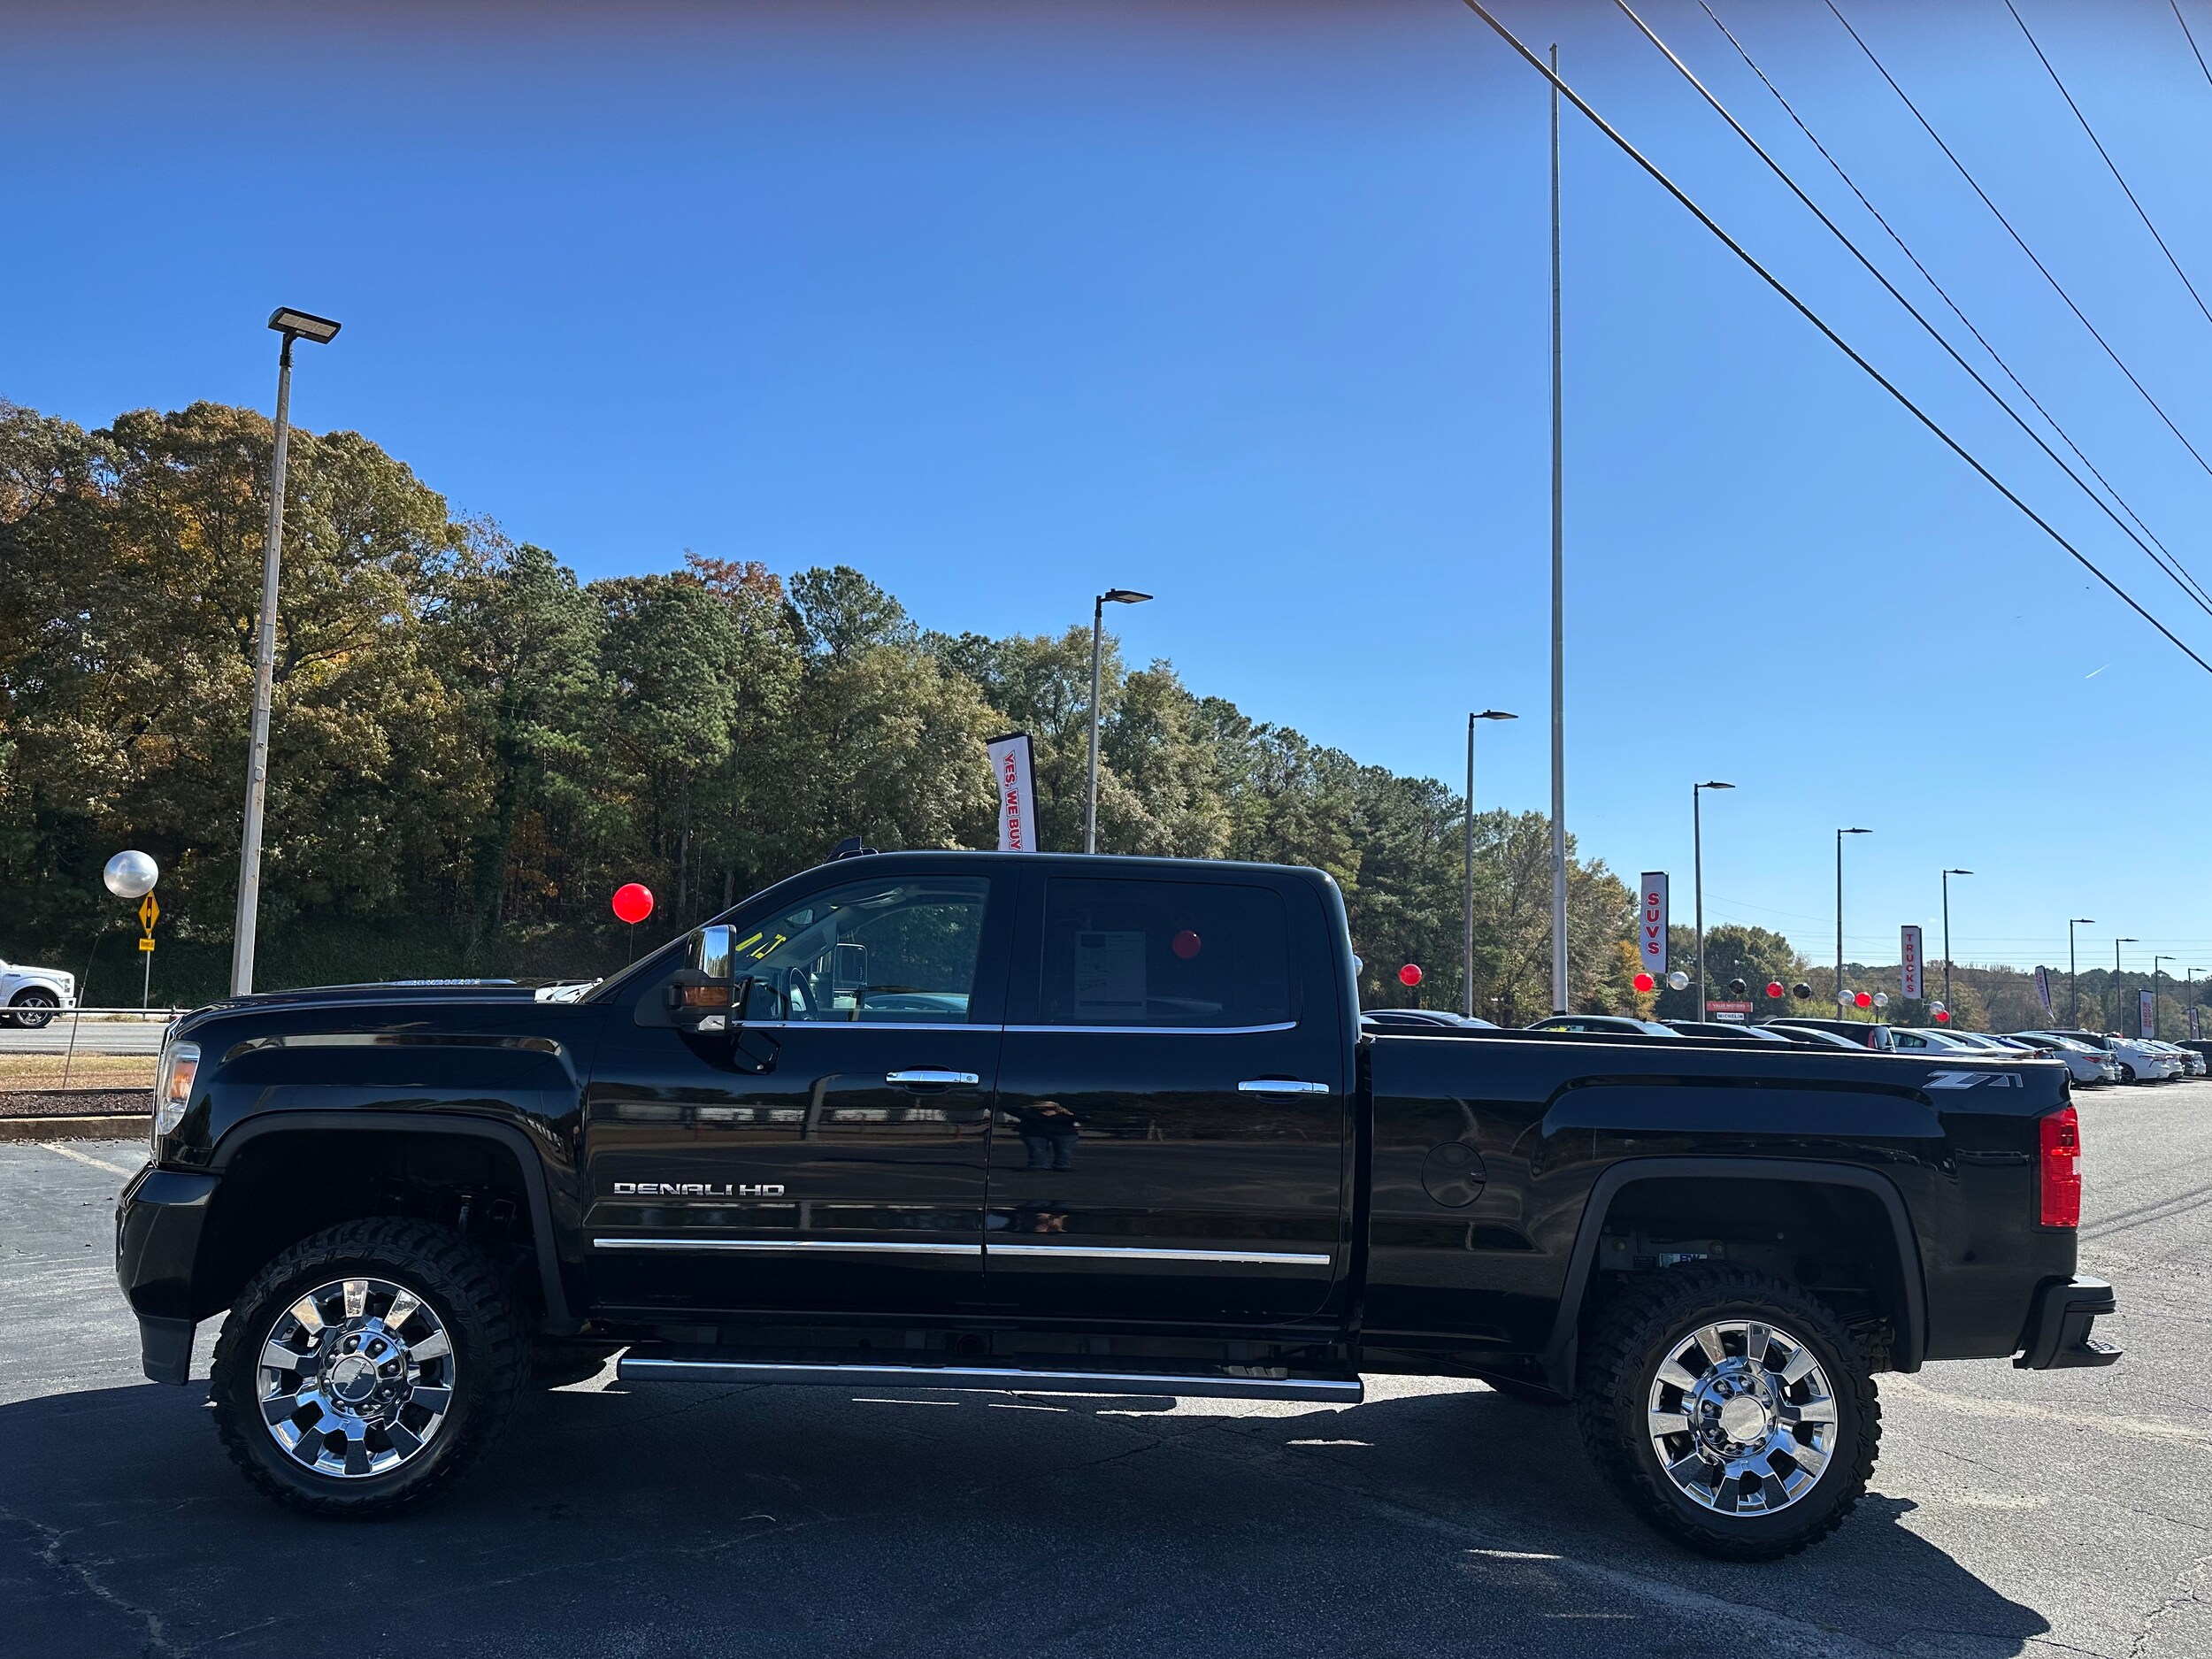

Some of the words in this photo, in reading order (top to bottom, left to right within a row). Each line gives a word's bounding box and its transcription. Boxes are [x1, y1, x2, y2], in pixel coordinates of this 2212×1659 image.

[1004, 751, 1017, 787] YES,
[1006, 788, 1019, 816] WE
[1009, 818, 1022, 851] BUY
[1645, 892, 1661, 956] SUVS
[1906, 933, 1915, 993] TRUCKS
[1922, 1070, 2024, 1089] Z71
[613, 1182, 733, 1195] DENALI
[739, 1184, 785, 1196] HD
